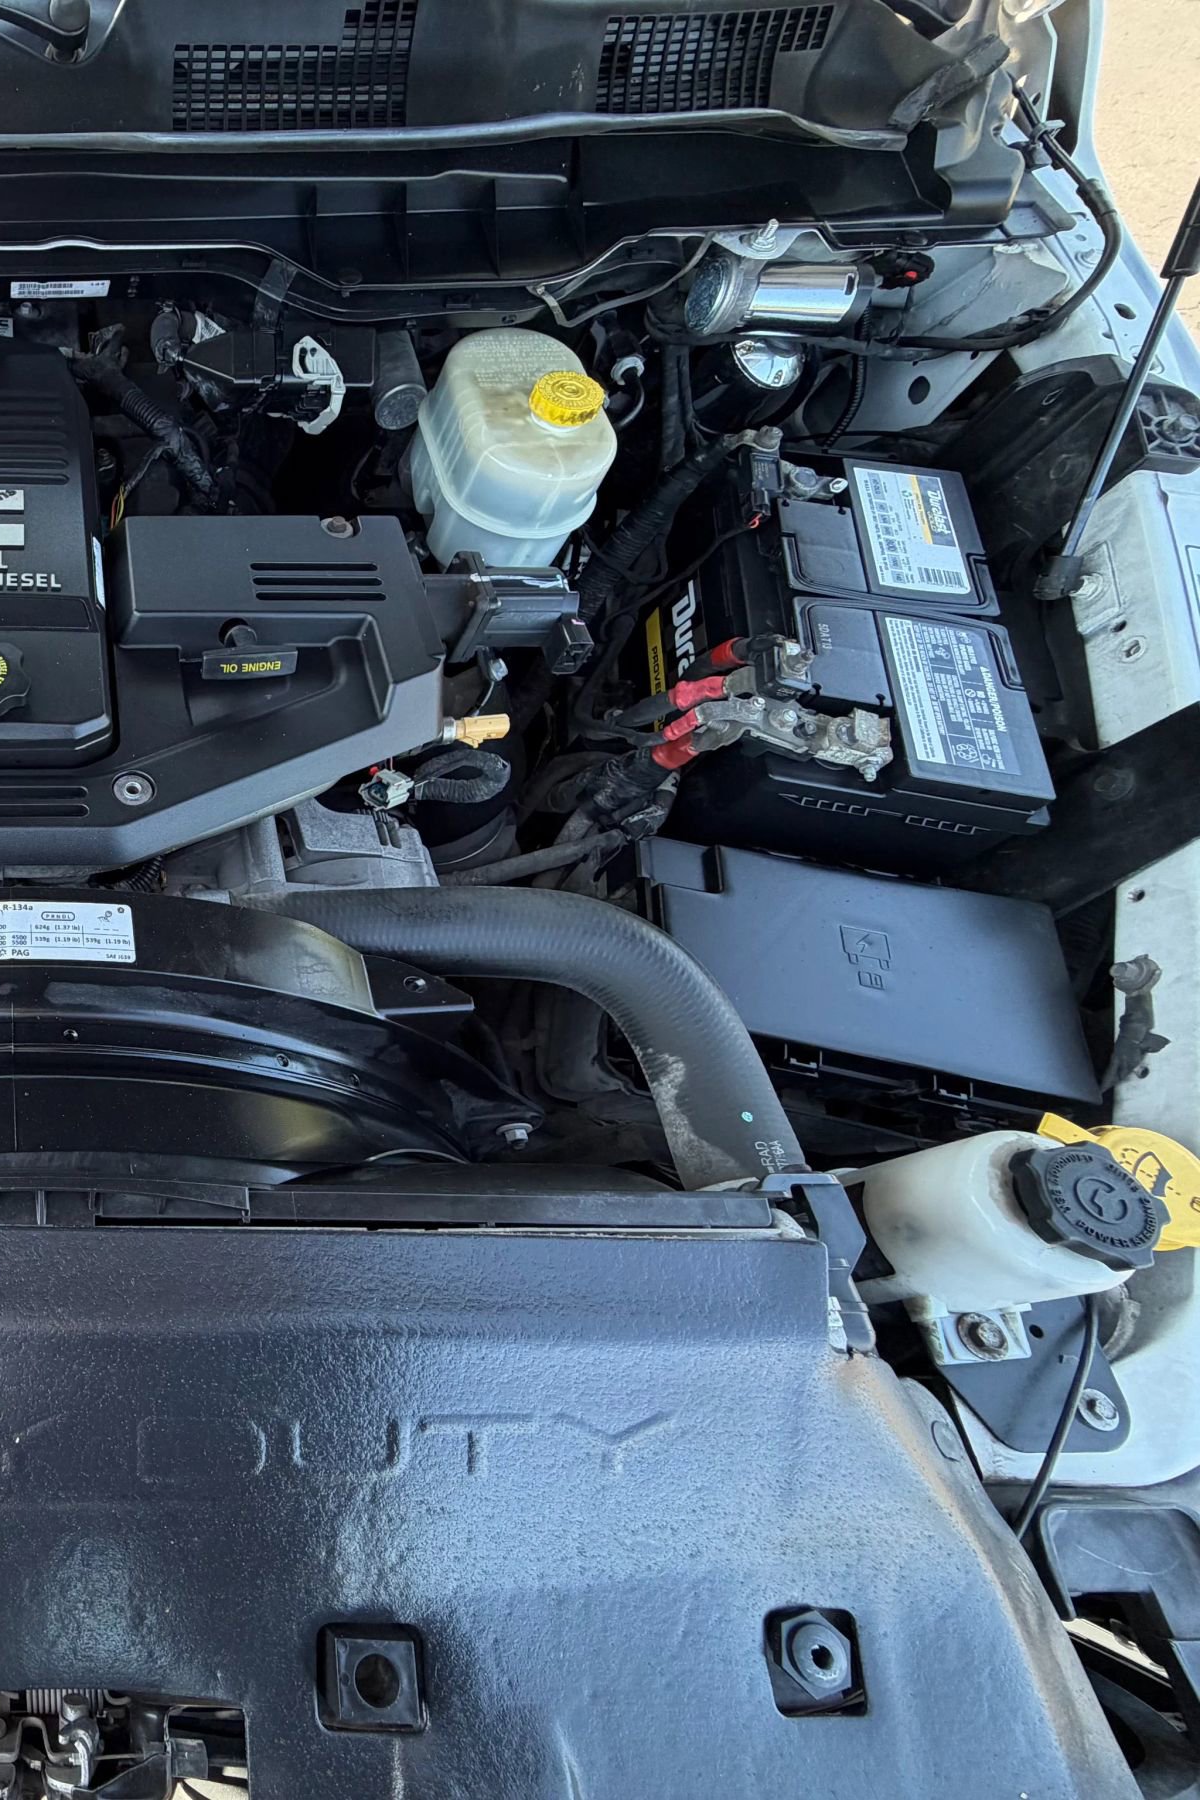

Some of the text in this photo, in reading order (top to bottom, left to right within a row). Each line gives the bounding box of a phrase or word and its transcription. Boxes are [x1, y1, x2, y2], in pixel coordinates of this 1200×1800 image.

[927, 490, 951, 534] Duralast
[220, 661, 281, 673] ENGINE OIL
[754, 1141, 776, 1166] RAD
[1076, 1220, 1130, 1248] POWER
[136, 1408, 678, 1481] DUTY
